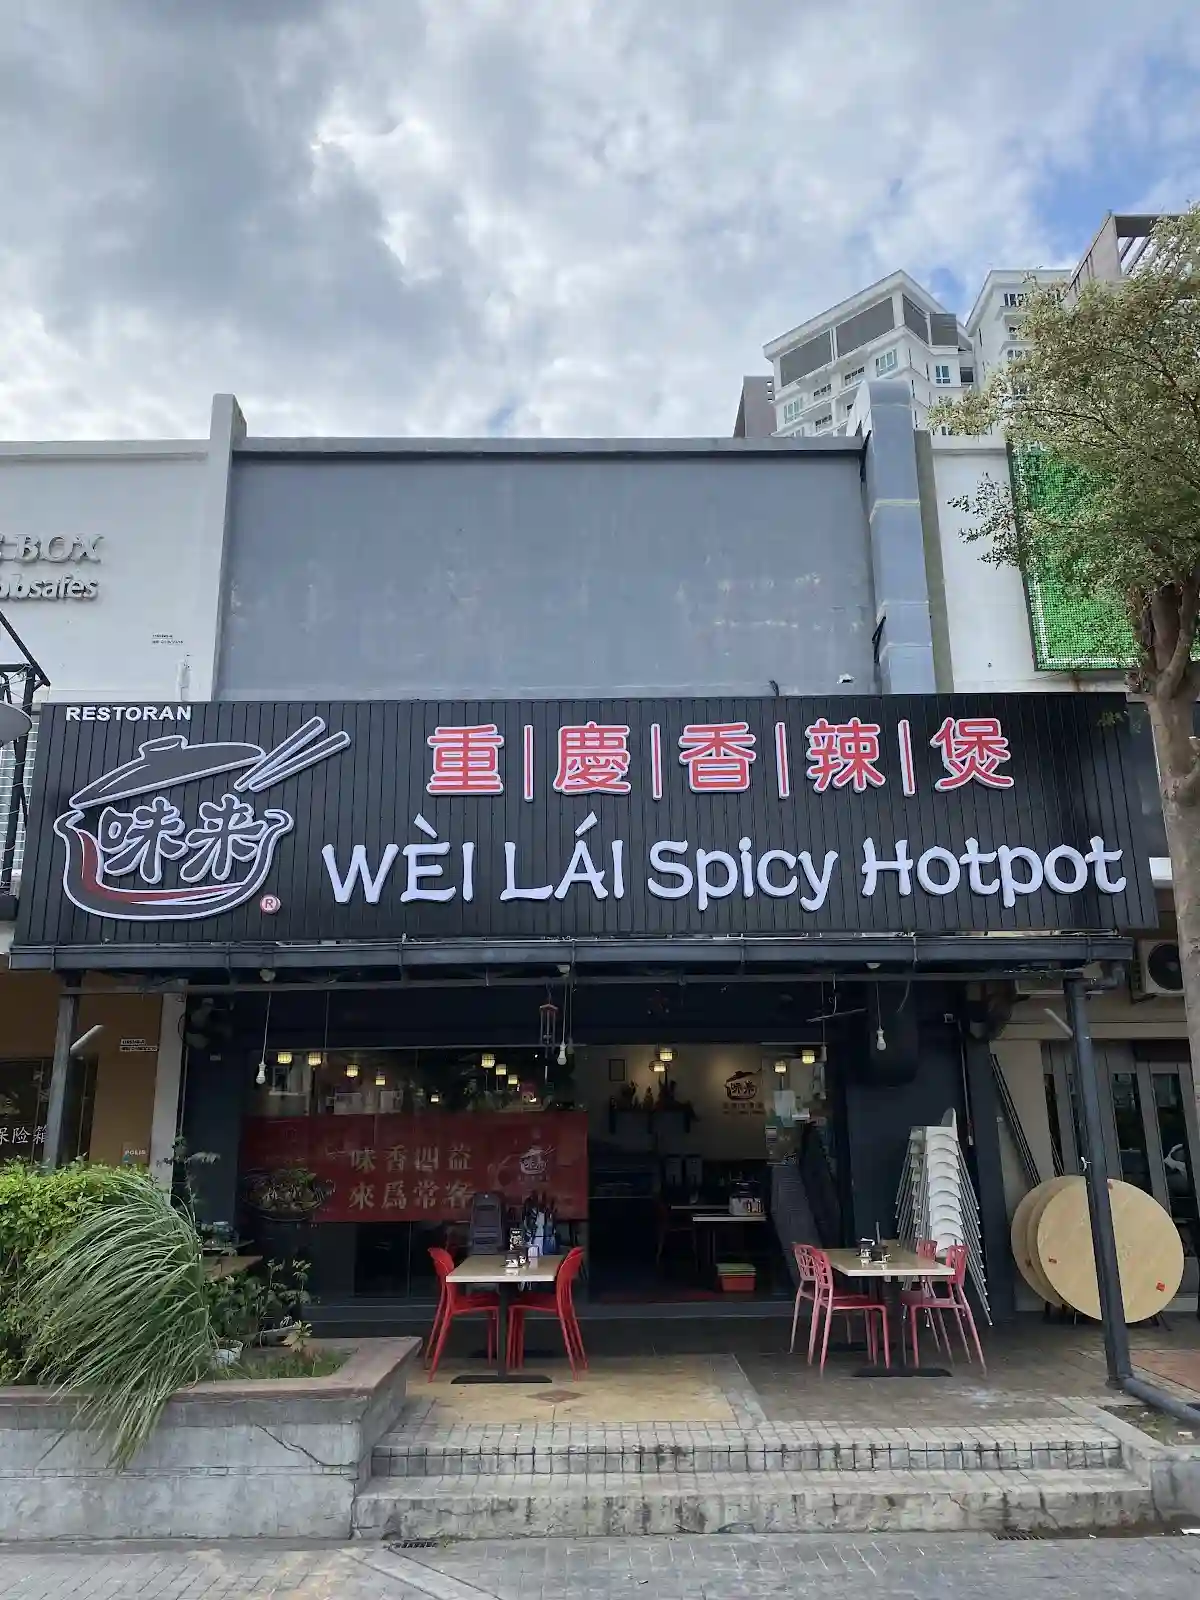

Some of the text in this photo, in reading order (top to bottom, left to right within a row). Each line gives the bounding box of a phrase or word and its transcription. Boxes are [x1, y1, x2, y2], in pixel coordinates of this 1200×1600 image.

[66, 706, 192, 722] RESTORAN
[321, 811, 1127, 912] WÈI LÁI Spicy Hotpot
